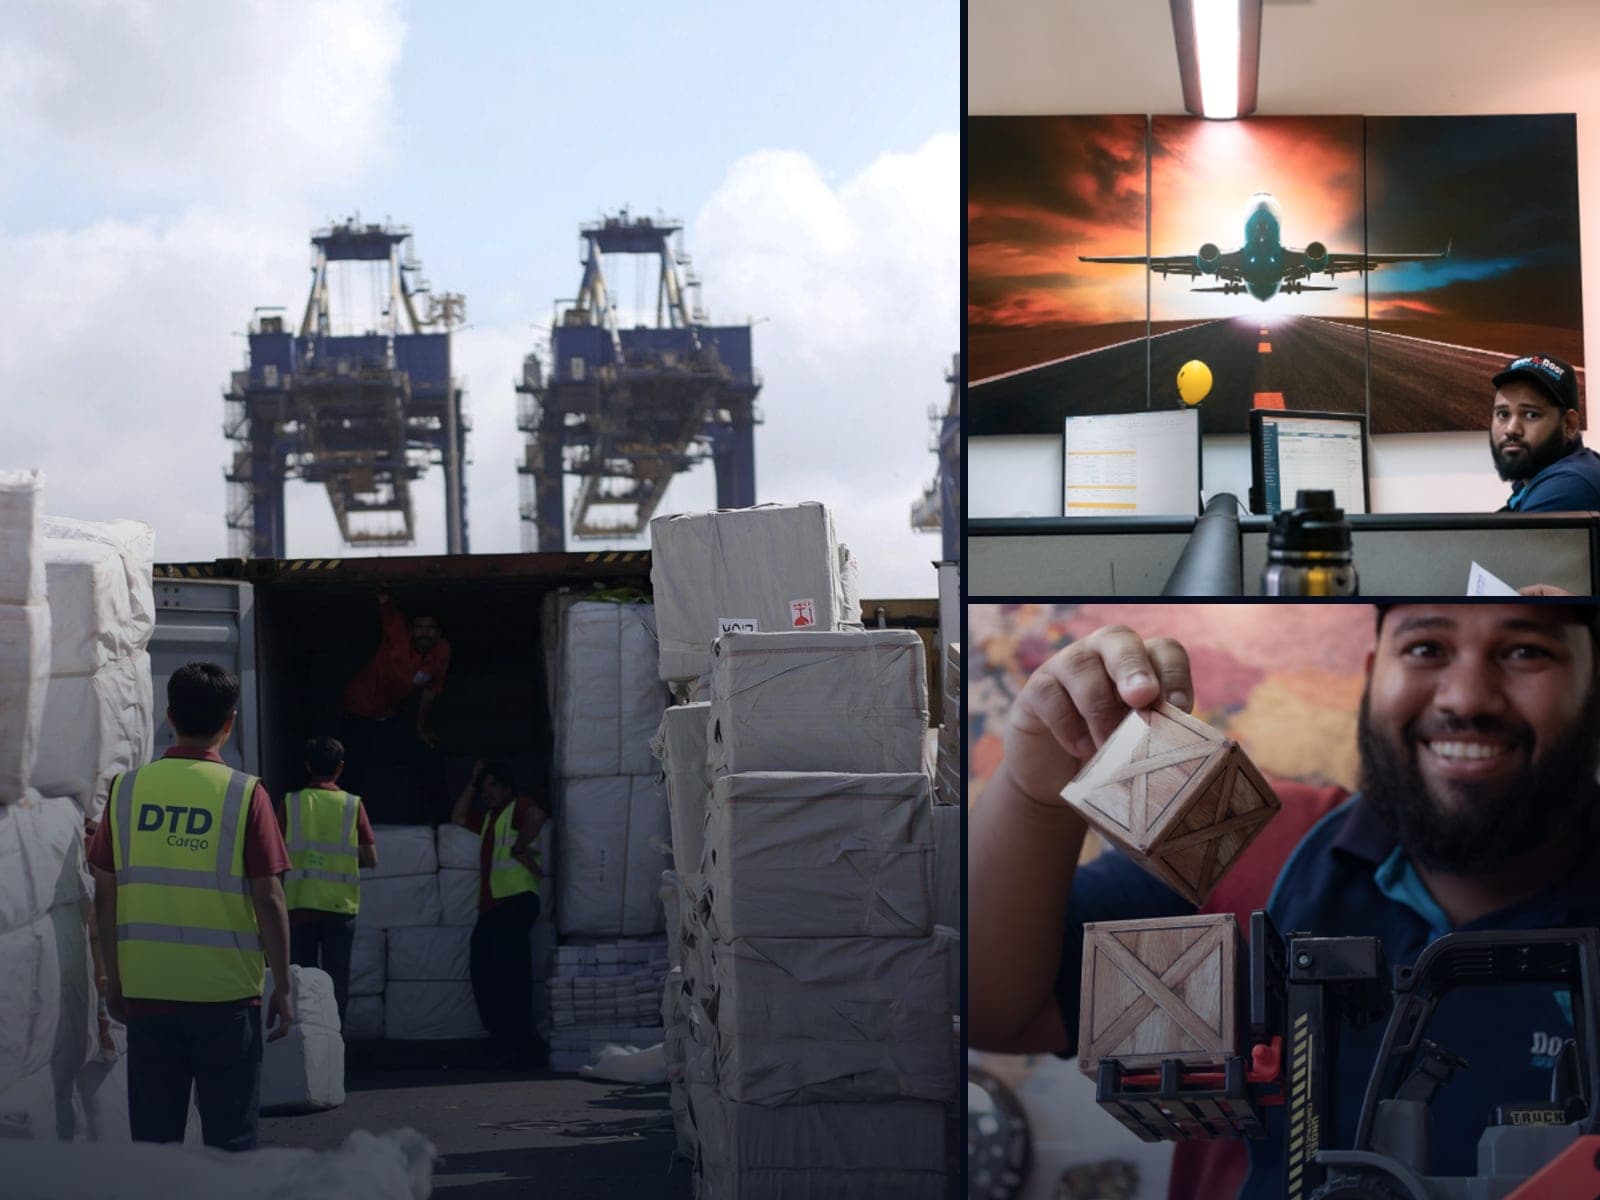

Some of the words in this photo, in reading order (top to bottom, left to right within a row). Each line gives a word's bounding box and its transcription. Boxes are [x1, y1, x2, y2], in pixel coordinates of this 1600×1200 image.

[137, 803, 213, 835] DTD
[166, 834, 209, 851] Cargo
[1511, 1110, 1566, 1126] TRUCK
